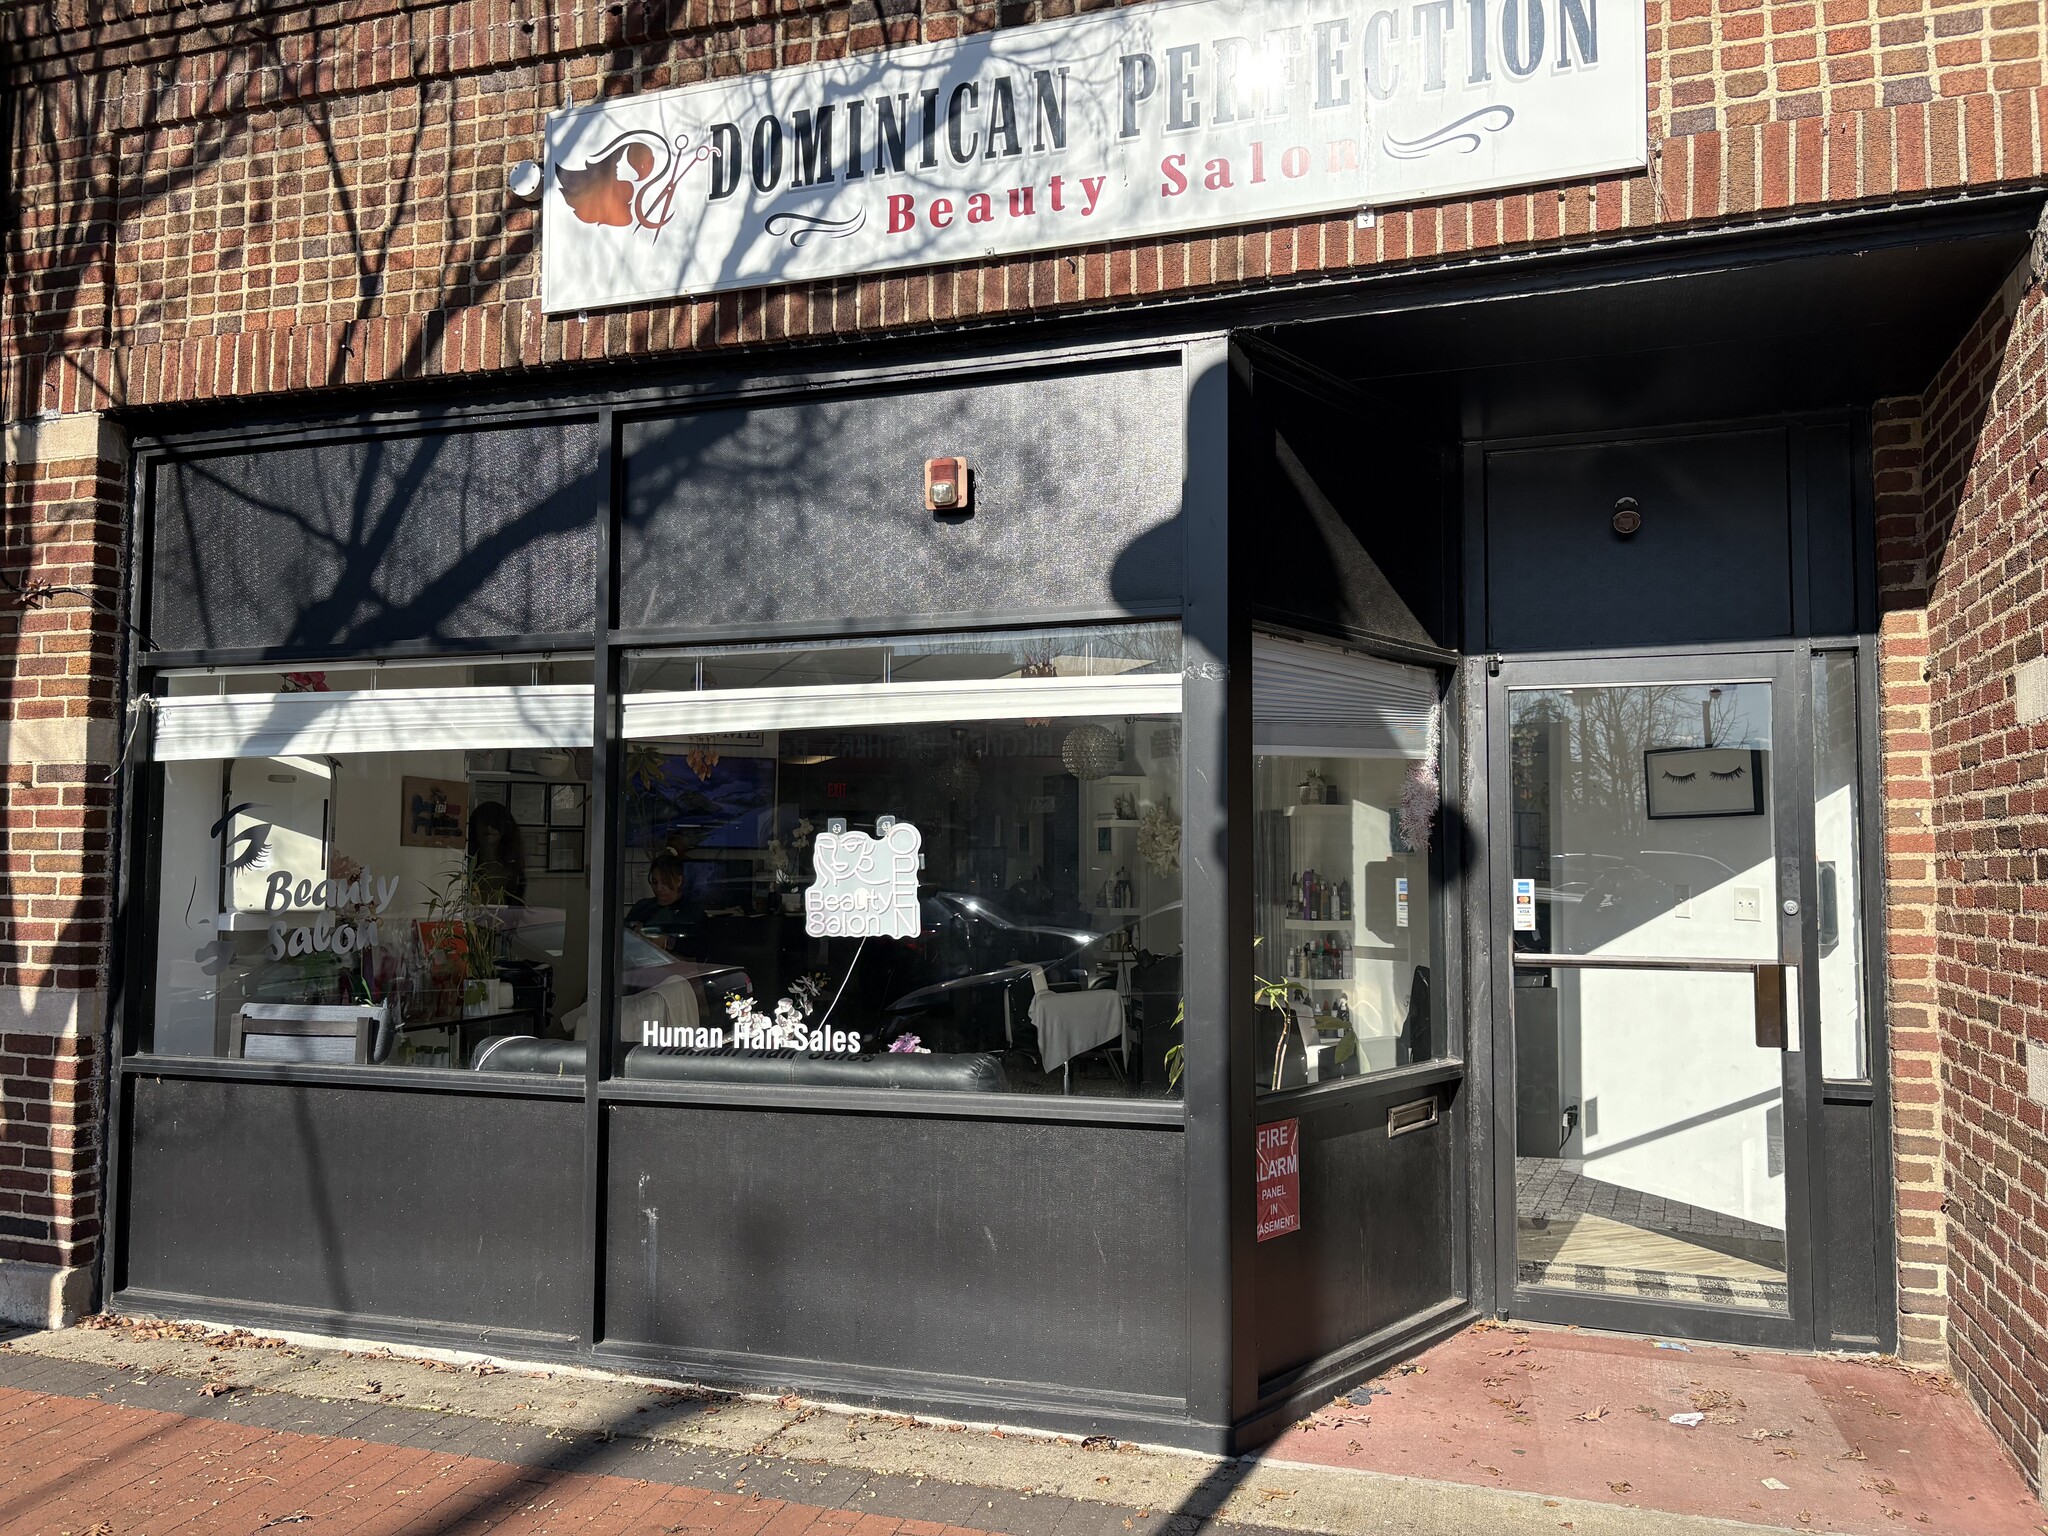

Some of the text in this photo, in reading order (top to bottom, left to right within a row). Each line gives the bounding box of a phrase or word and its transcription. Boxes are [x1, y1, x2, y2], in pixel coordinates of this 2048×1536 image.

[708, 0, 1599, 201] DOMINICAN PERFECTION
[886, 138, 1360, 234] Beauty Salon
[828, 783, 847, 799] EXIT
[265, 864, 400, 918] Beauty
[888, 825, 918, 938] OPEN
[808, 888, 894, 915] Beauty
[264, 911, 379, 962] Salon
[808, 911, 881, 936] Salon
[643, 1020, 861, 1053] Human Hair Sales
[1258, 1126, 1288, 1151] FIRE
[1261, 1185, 1287, 1201] PANEL
[1270, 1203, 1278, 1216] IN
